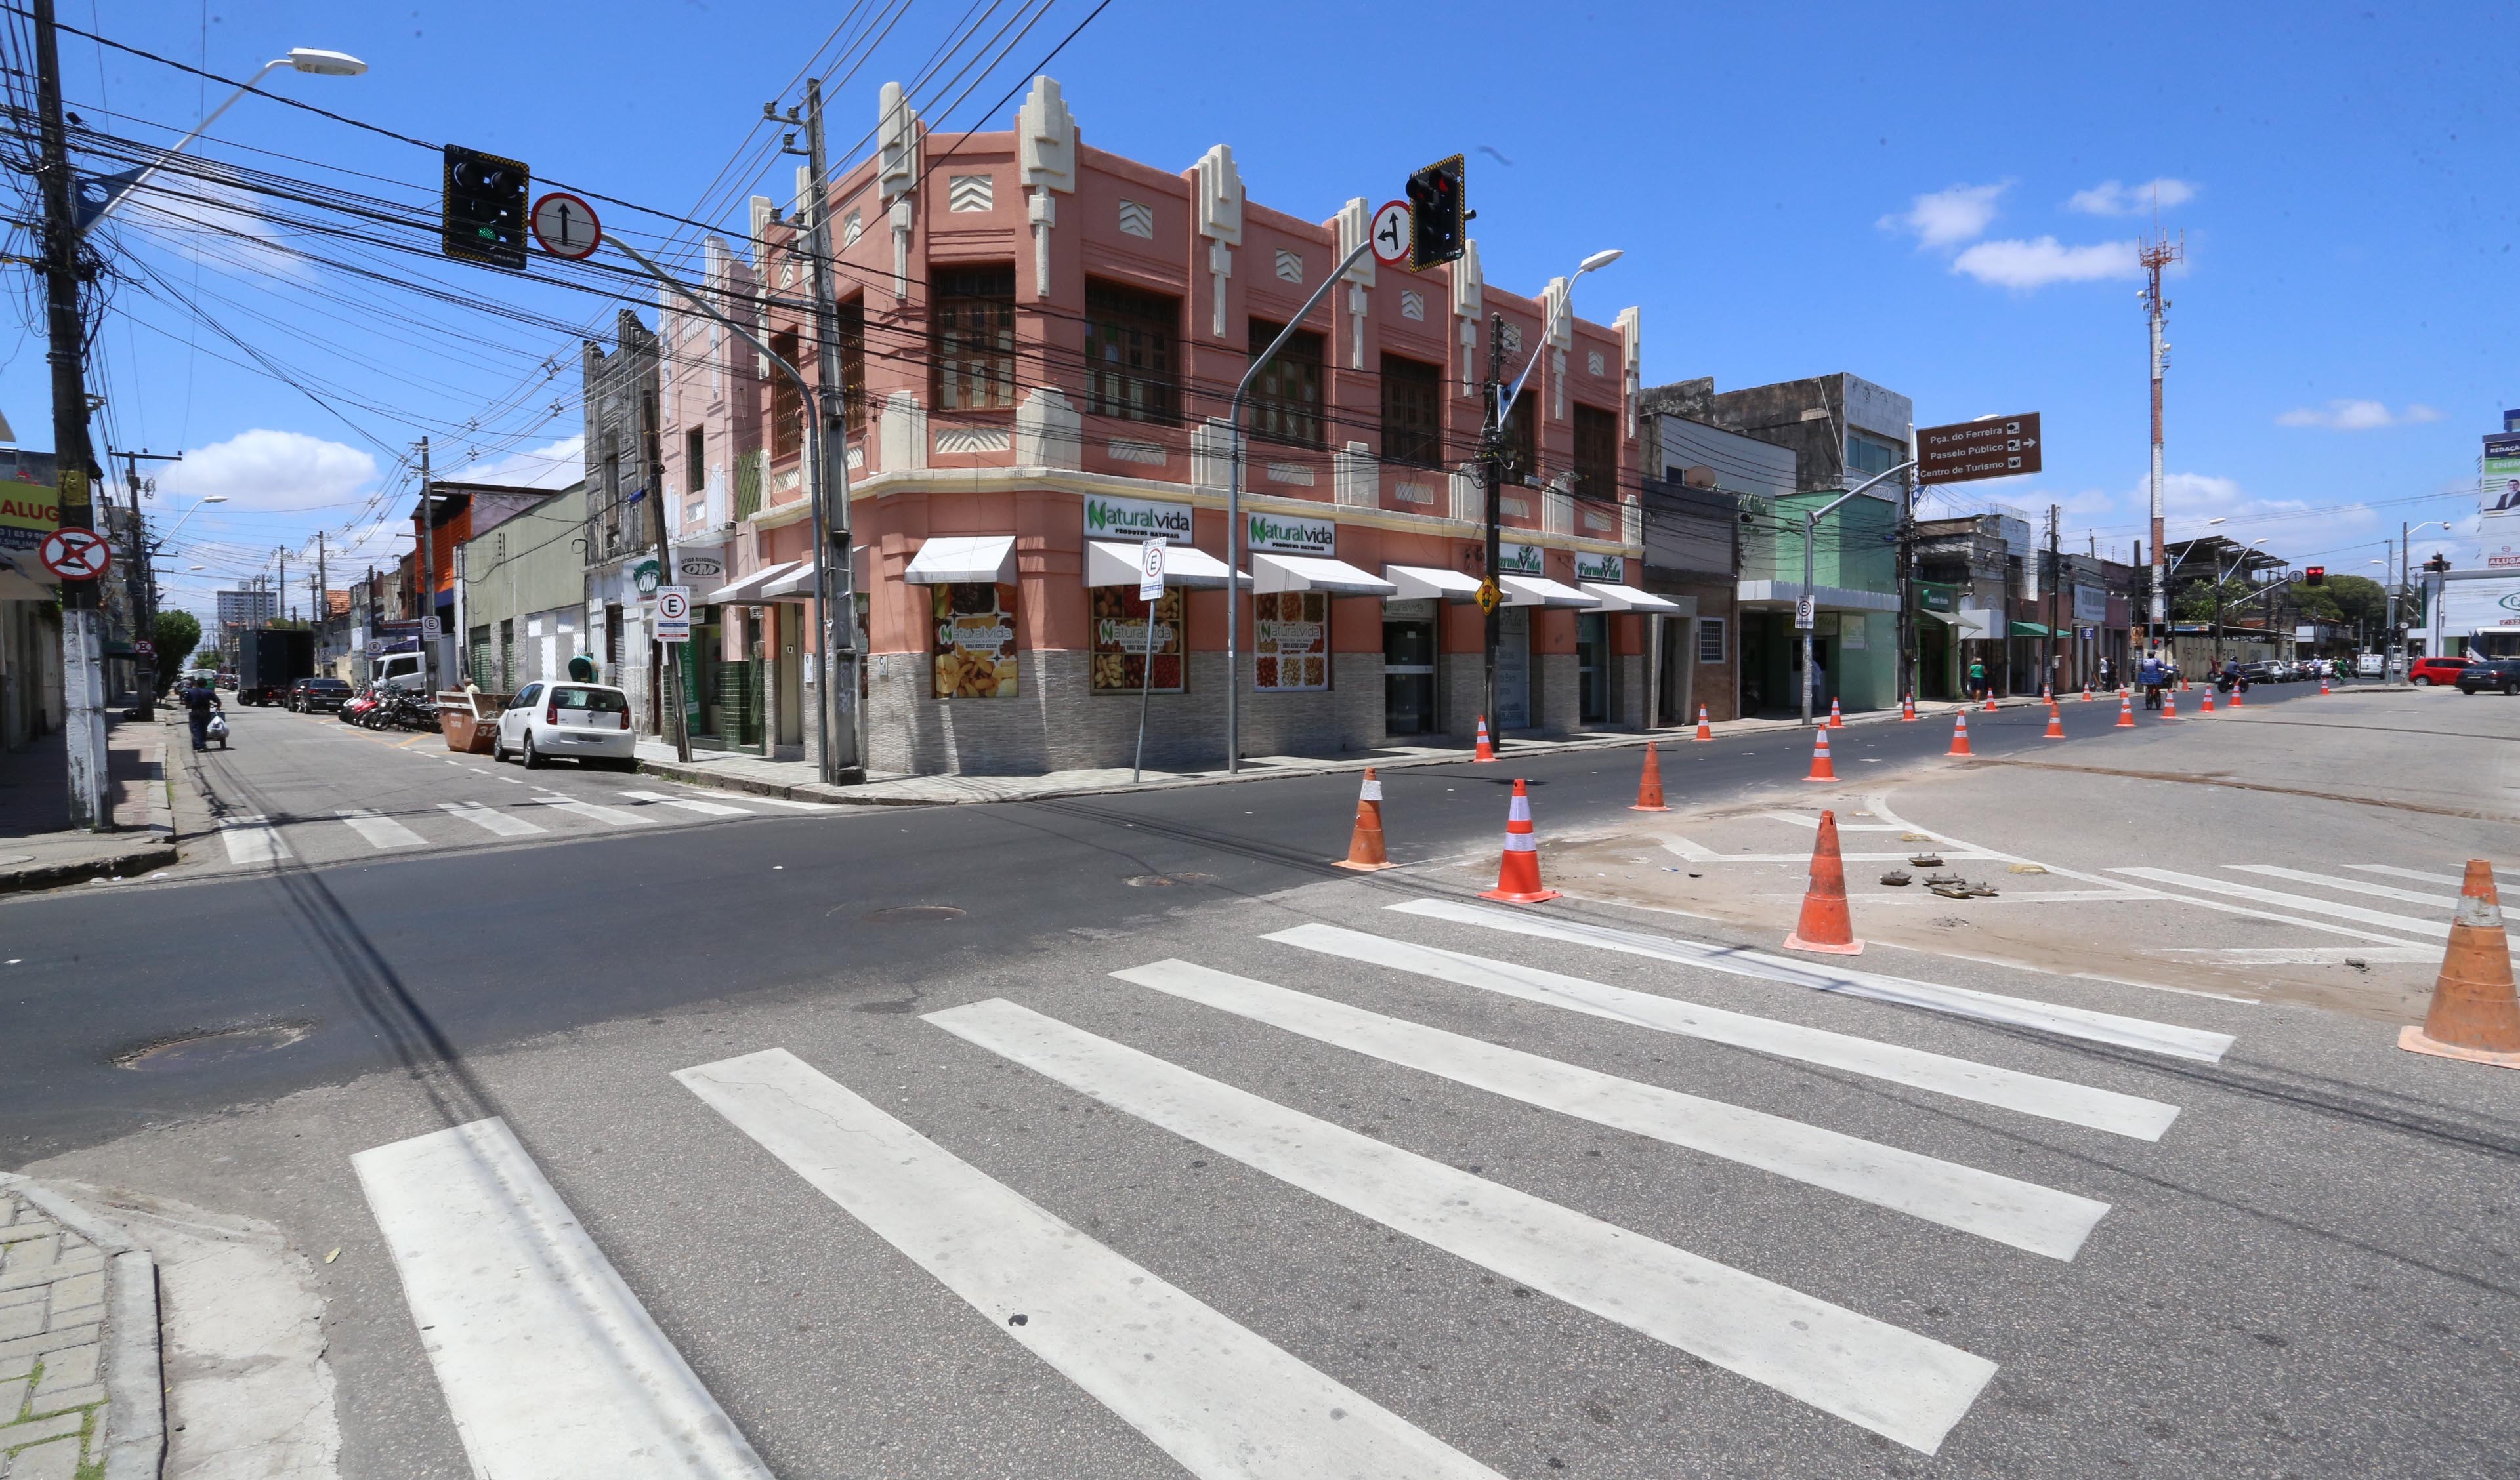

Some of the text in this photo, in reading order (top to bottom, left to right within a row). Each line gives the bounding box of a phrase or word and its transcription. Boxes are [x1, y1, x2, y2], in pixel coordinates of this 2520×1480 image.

[1966, 428, 2002, 438] Ferreira
[1930, 444, 2004, 460] Passeio Público
[1920, 468, 1950, 478] Centro
[1965, 461, 2004, 472] Turismo
[1088, 499, 1190, 531] Naturalvida
[1115, 528, 1148, 537] PRODUTOS
[1251, 516, 1333, 545] Naturalvida
[685, 564, 716, 575] OM
[1150, 555, 1157, 570] E
[669, 599, 677, 612] E
[1802, 604, 1807, 613] E
[941, 627, 1011, 642] Naturalvida
[1261, 622, 1320, 638] Naturalvida
[477, 726, 497, 737] 32
